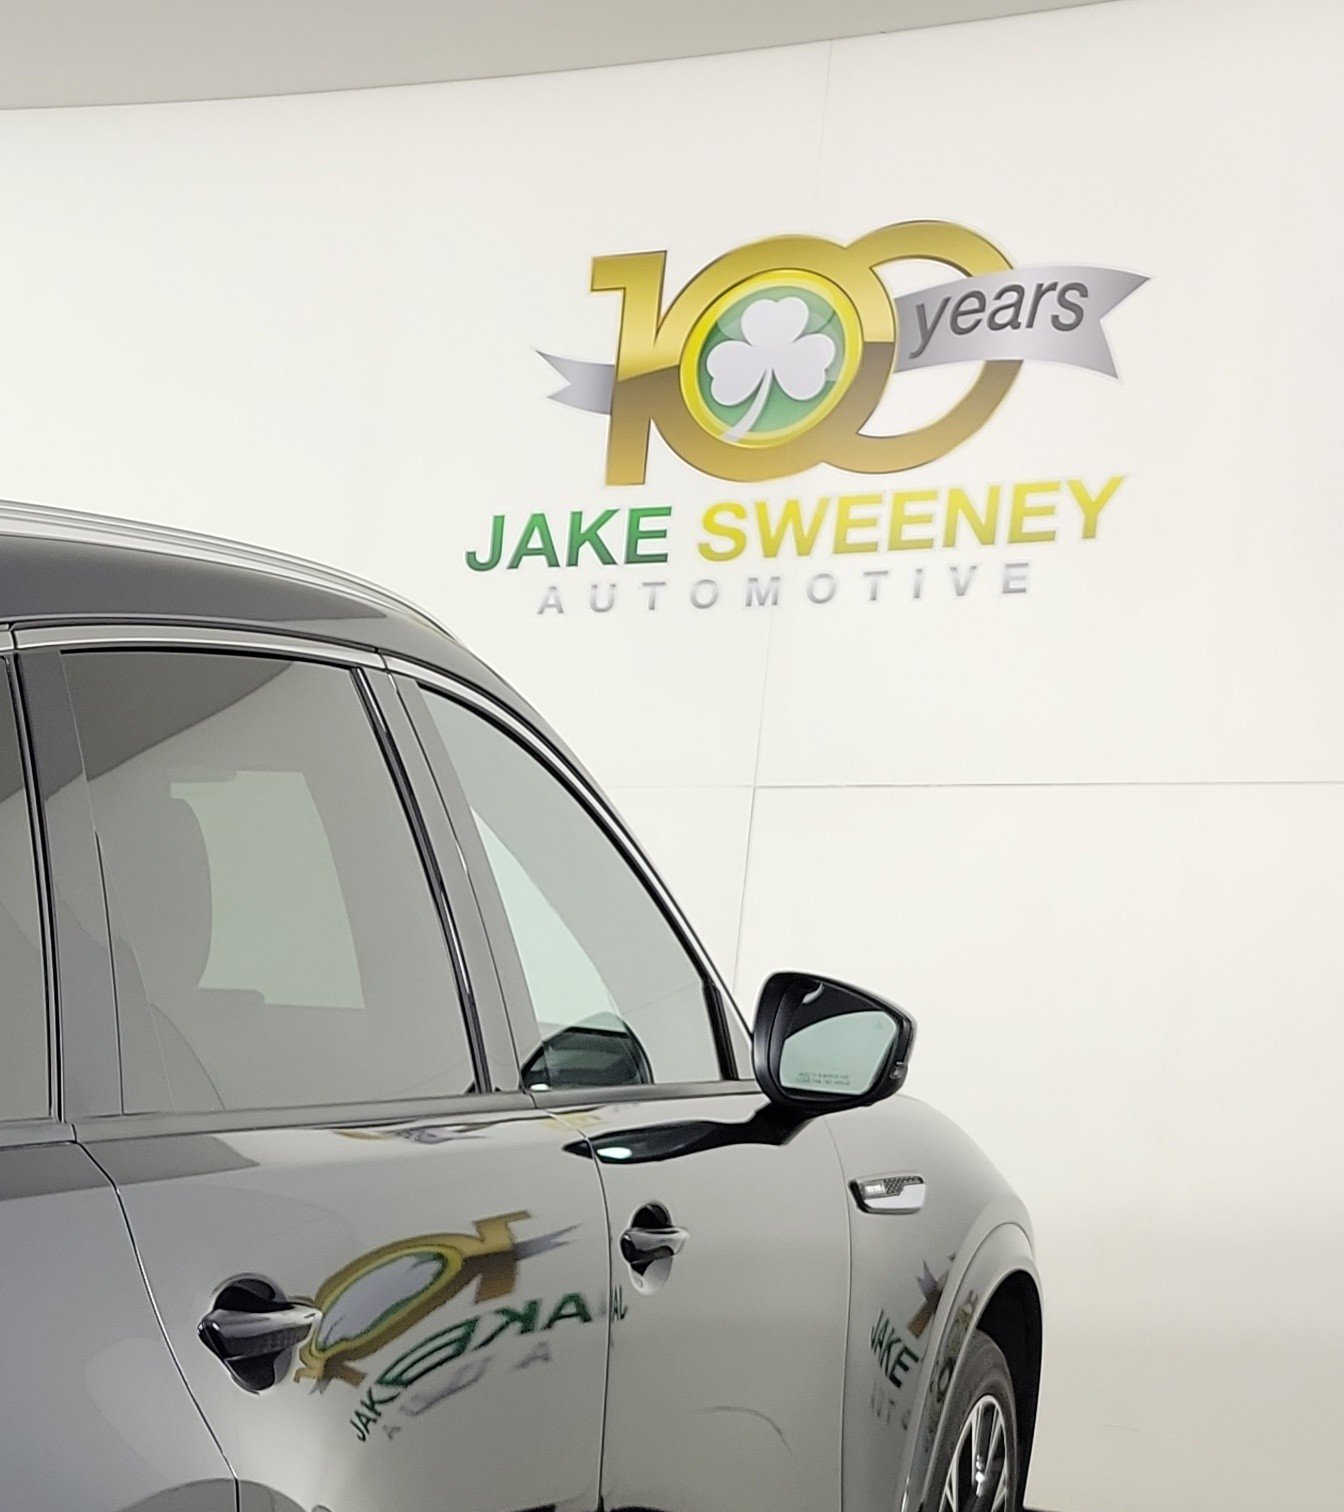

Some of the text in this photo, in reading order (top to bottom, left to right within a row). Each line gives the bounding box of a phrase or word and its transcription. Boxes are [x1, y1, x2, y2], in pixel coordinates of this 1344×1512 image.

[590, 219, 1090, 487] 100 years
[465, 474, 1126, 574] JAKE SWEENEY
[536, 561, 1032, 616] AUTOMOTIVE
